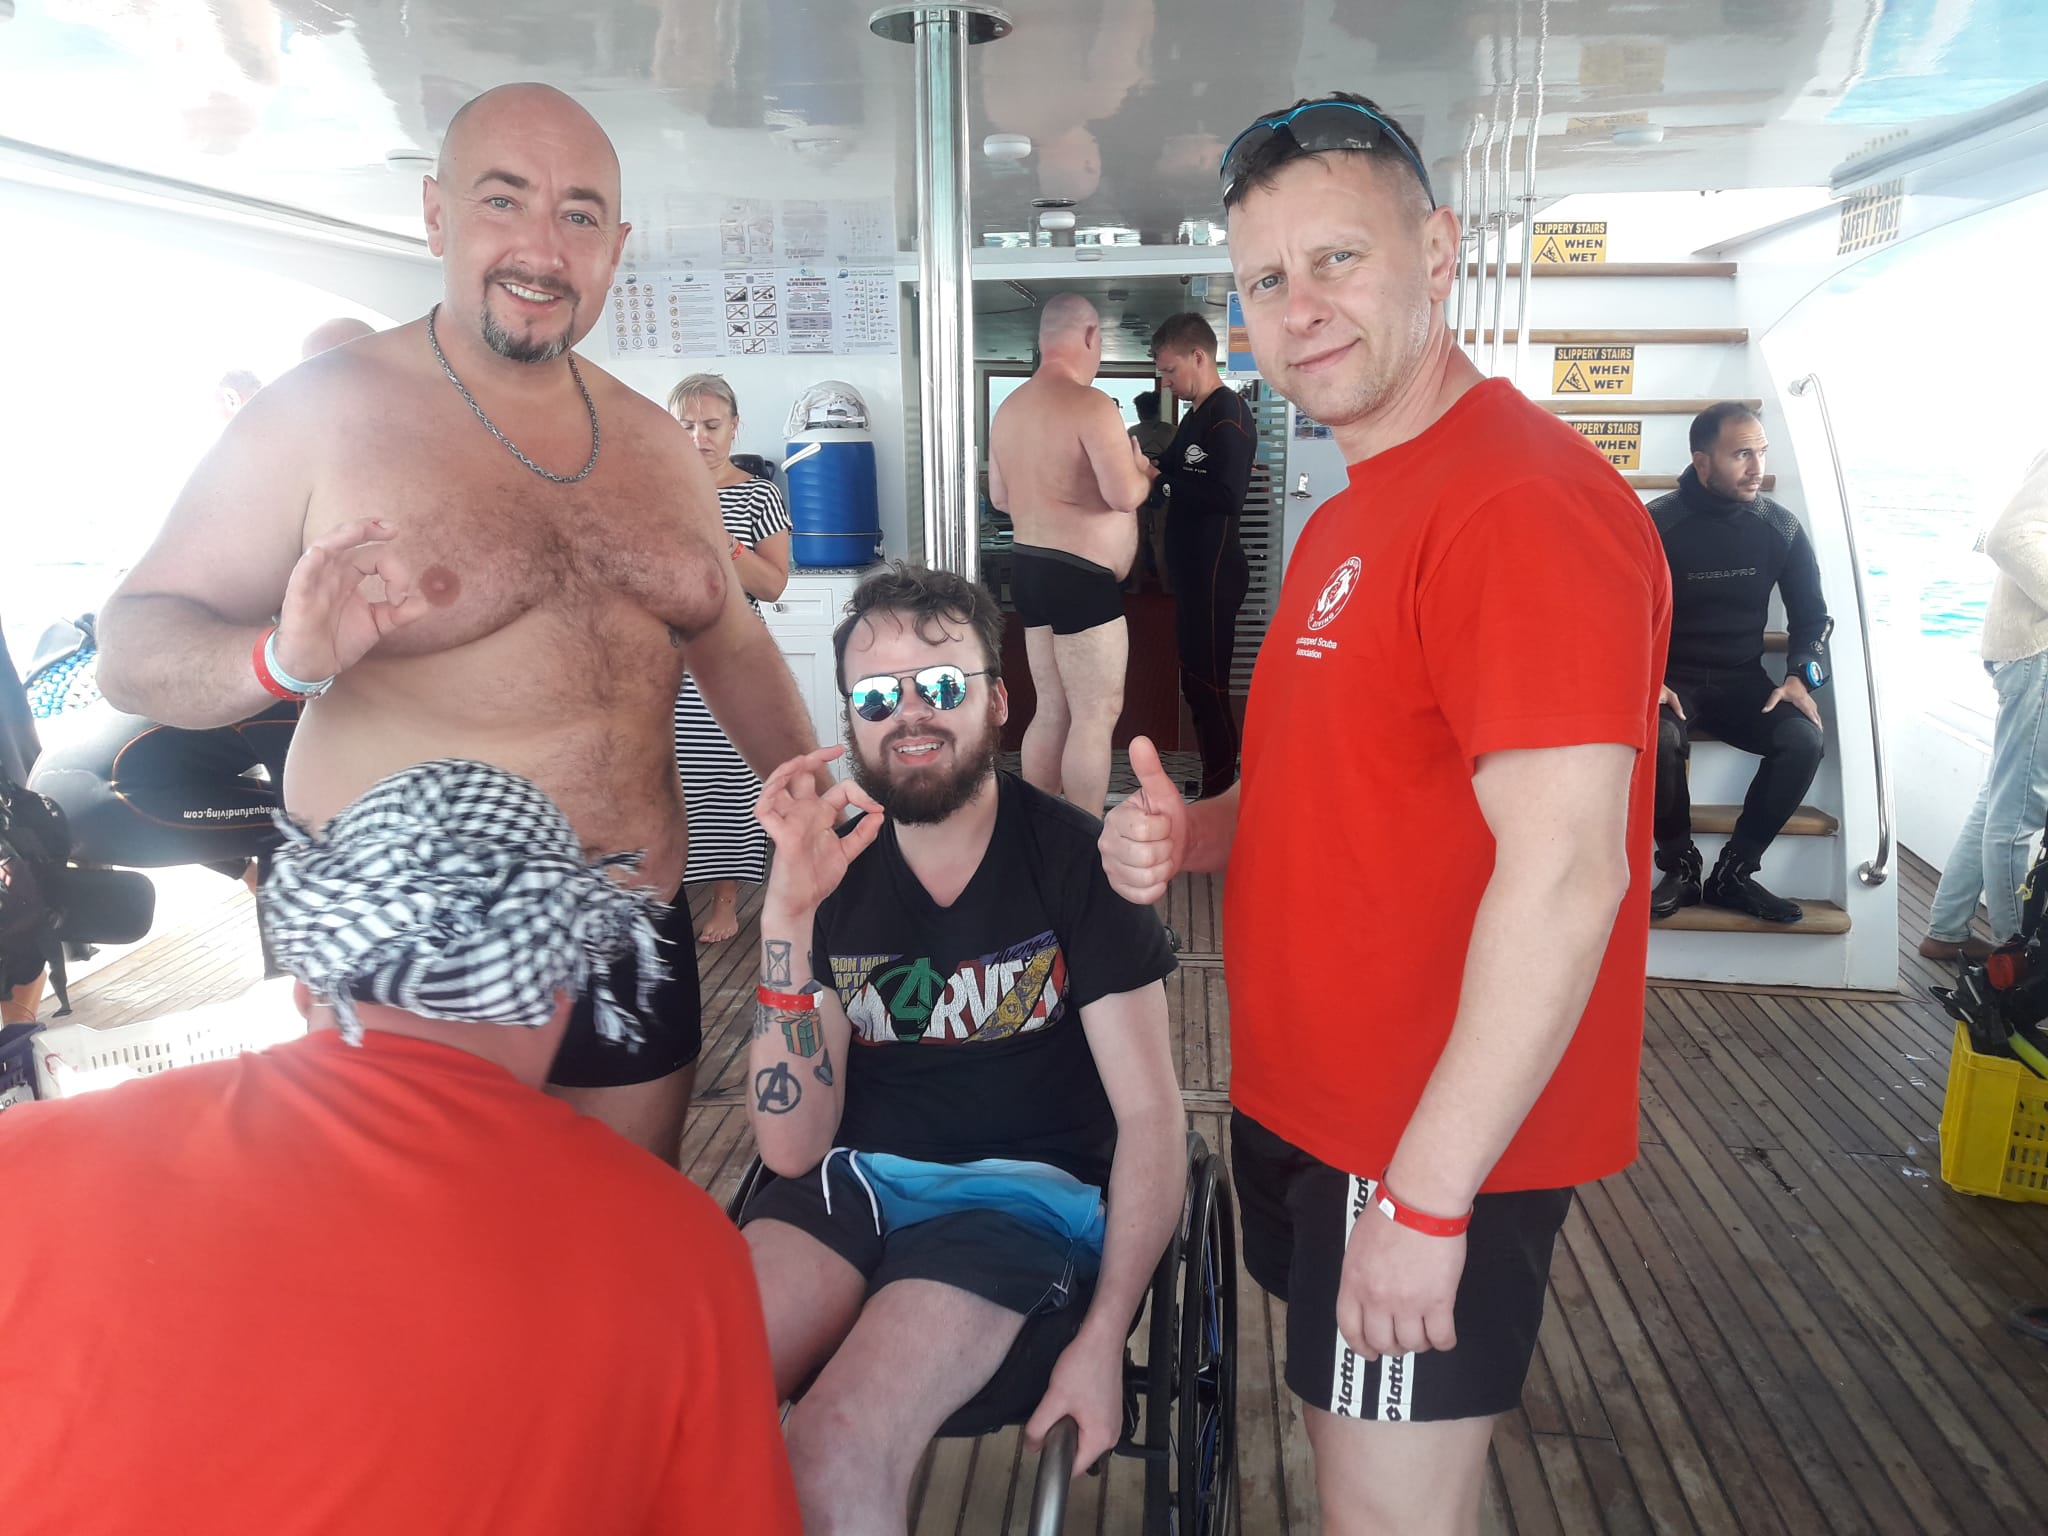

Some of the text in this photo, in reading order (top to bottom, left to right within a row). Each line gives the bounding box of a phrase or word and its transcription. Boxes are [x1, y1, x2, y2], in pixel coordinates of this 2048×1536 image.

[1840, 198, 1901, 244] SAFETY FIRST
[1534, 223, 1605, 234] SLIPPERY STAIRS
[1564, 239, 1603, 249] WHEN
[1569, 252, 1597, 262] WET
[1557, 348, 1632, 360] SLIPPERY STAIRS
[1589, 365, 1630, 375] WHEN
[1594, 379, 1624, 389] WET
[1572, 422, 1639, 434] IPPERY STAIRS
[1595, 440, 1637, 450] WHEN
[1687, 567, 1758, 581] SCUBAPRO
[1338, 1347, 1355, 1406] lotto
